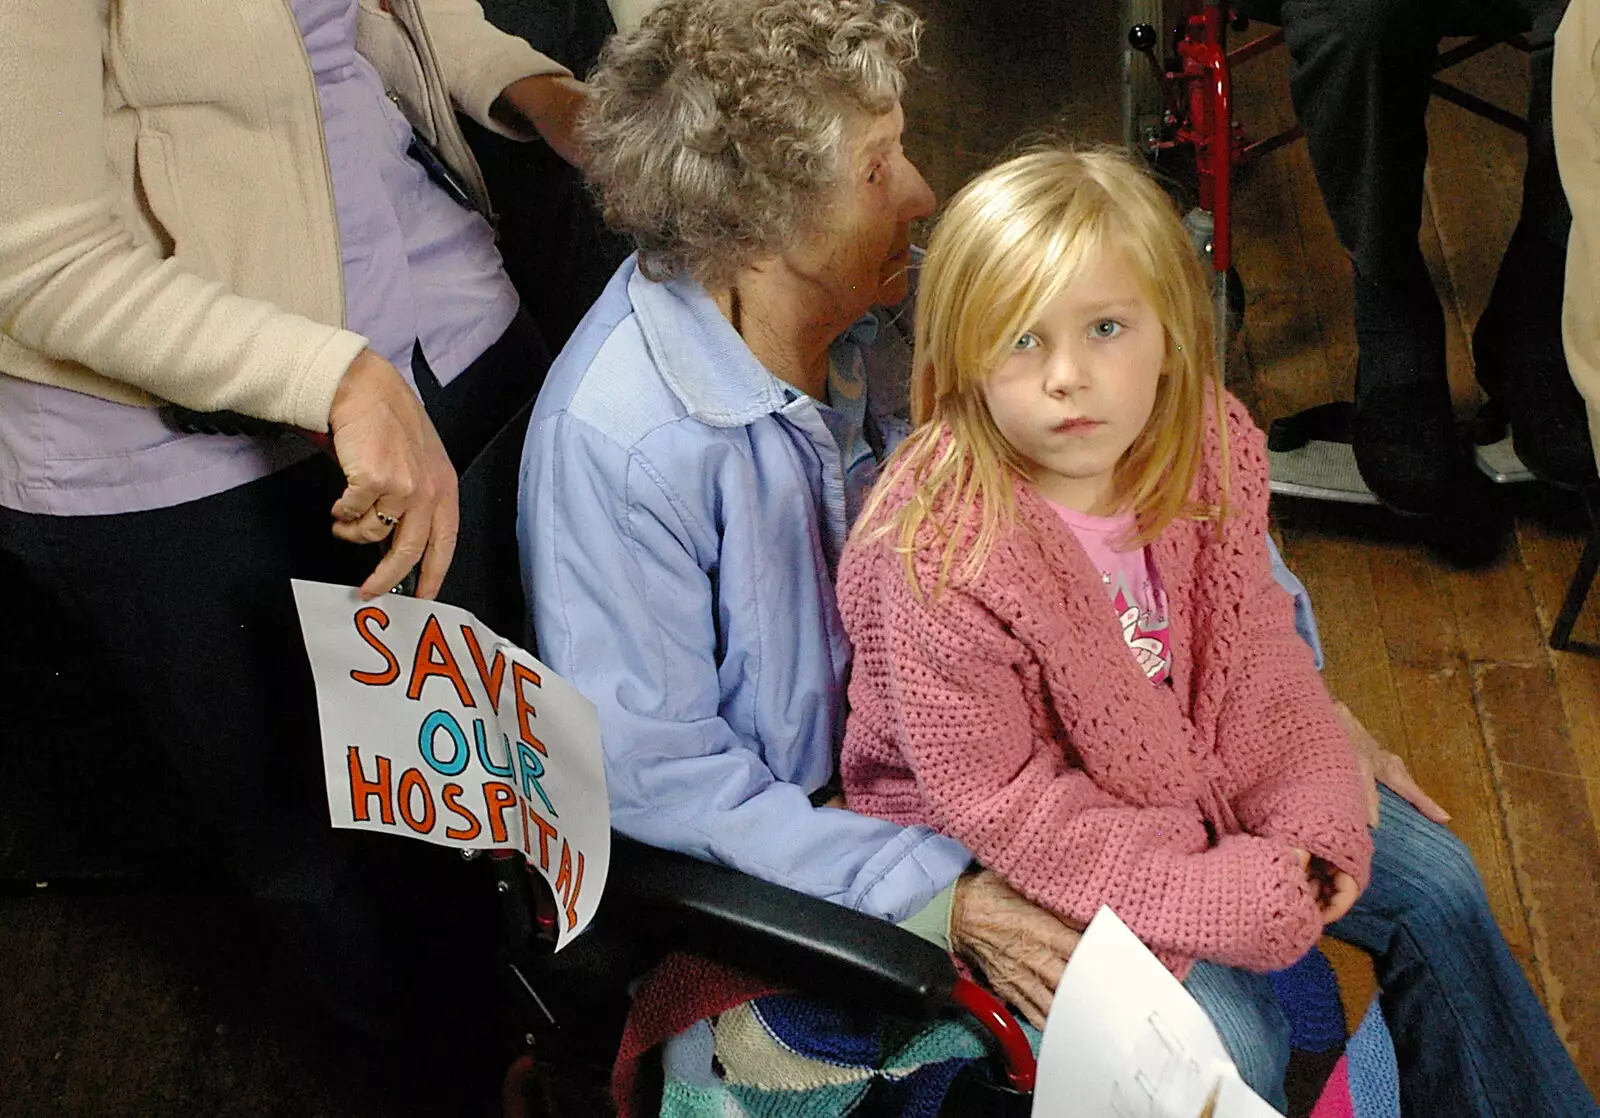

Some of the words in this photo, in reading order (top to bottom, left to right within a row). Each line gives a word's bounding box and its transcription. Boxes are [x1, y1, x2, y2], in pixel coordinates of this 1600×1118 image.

[350, 607, 548, 757] SAVE
[419, 709, 558, 817] OUR
[347, 746, 584, 932] HOSPITAL
